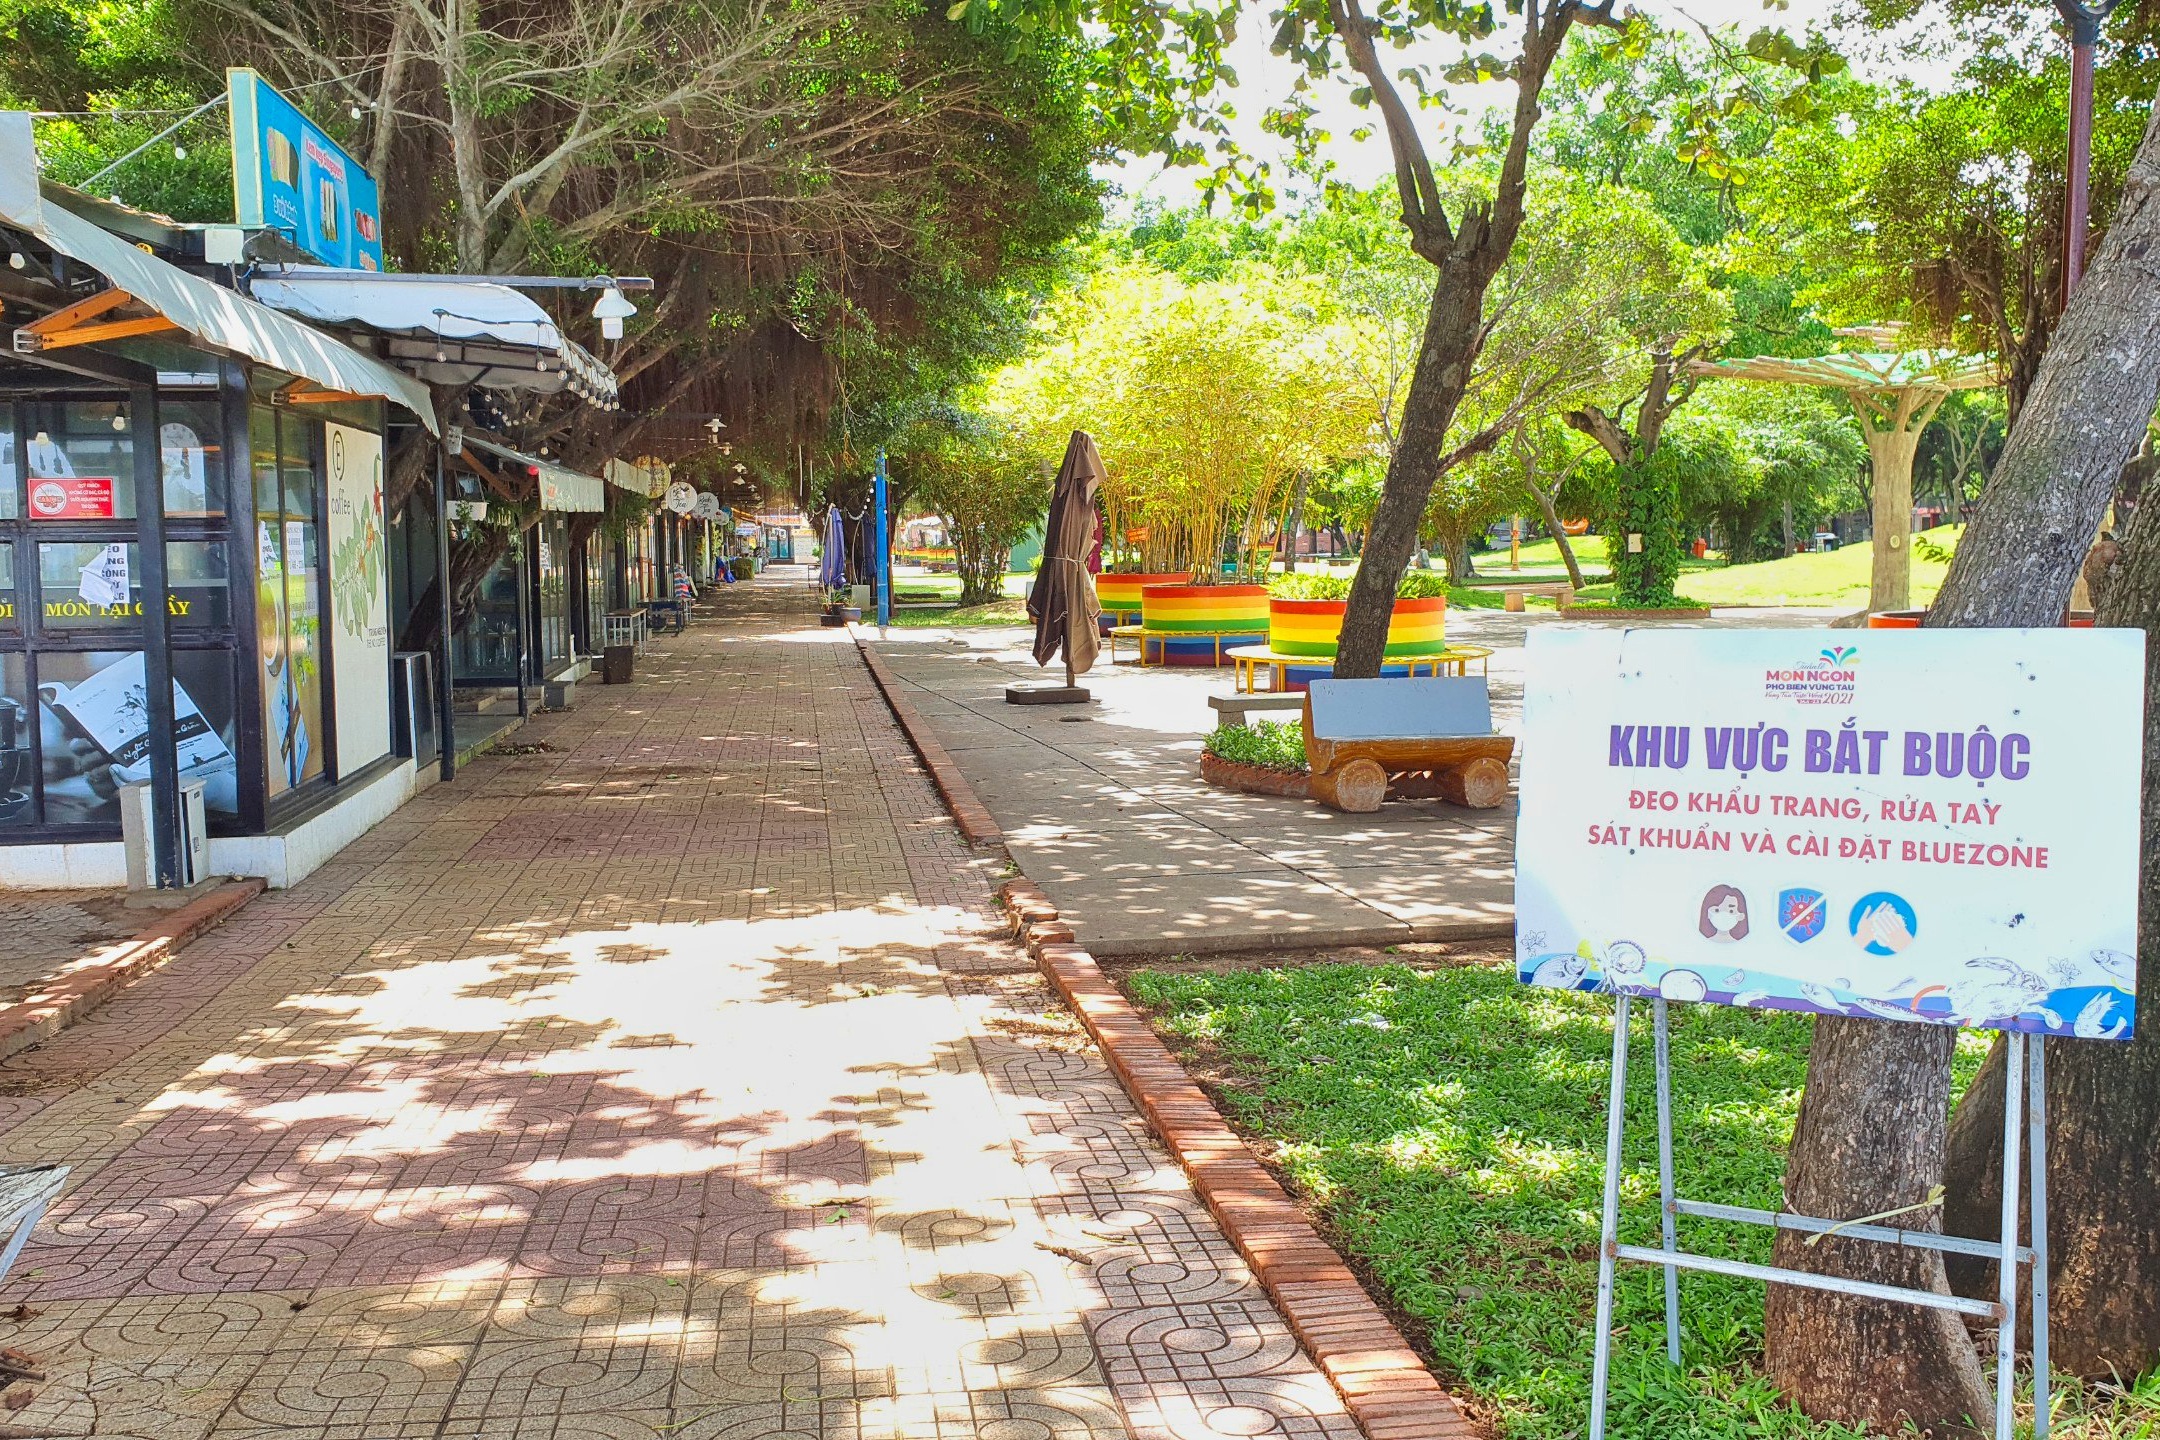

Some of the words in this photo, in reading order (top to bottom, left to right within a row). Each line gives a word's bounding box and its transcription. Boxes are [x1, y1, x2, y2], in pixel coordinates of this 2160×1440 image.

[331, 488, 351, 516] coffee
[46, 599, 91, 617] MÓN
[1807, 670, 1855, 682] NGON
[1822, 692, 1855, 705] 2021
[1609, 724, 1690, 769] KHU
[1704, 721, 1789, 779] VỰC
[1804, 716, 1889, 775] BẮT
[1903, 724, 2031, 788] BUỘC
[1629, 790, 1679, 811] ĐEO
[1688, 786, 1760, 815] KHẨU
[1770, 795, 1870, 823] TRANG,
[1881, 794, 1938, 823] RỬA
[1948, 802, 2002, 825] TAY
[1588, 820, 1631, 846] SÁT
[1639, 822, 1731, 852] KHUẨN
[1741, 827, 1777, 854] VÀ
[1786, 829, 1829, 857] CÀI
[1838, 833, 1892, 864] ĐẶT
[1901, 840, 2049, 868] BLUEZONE
